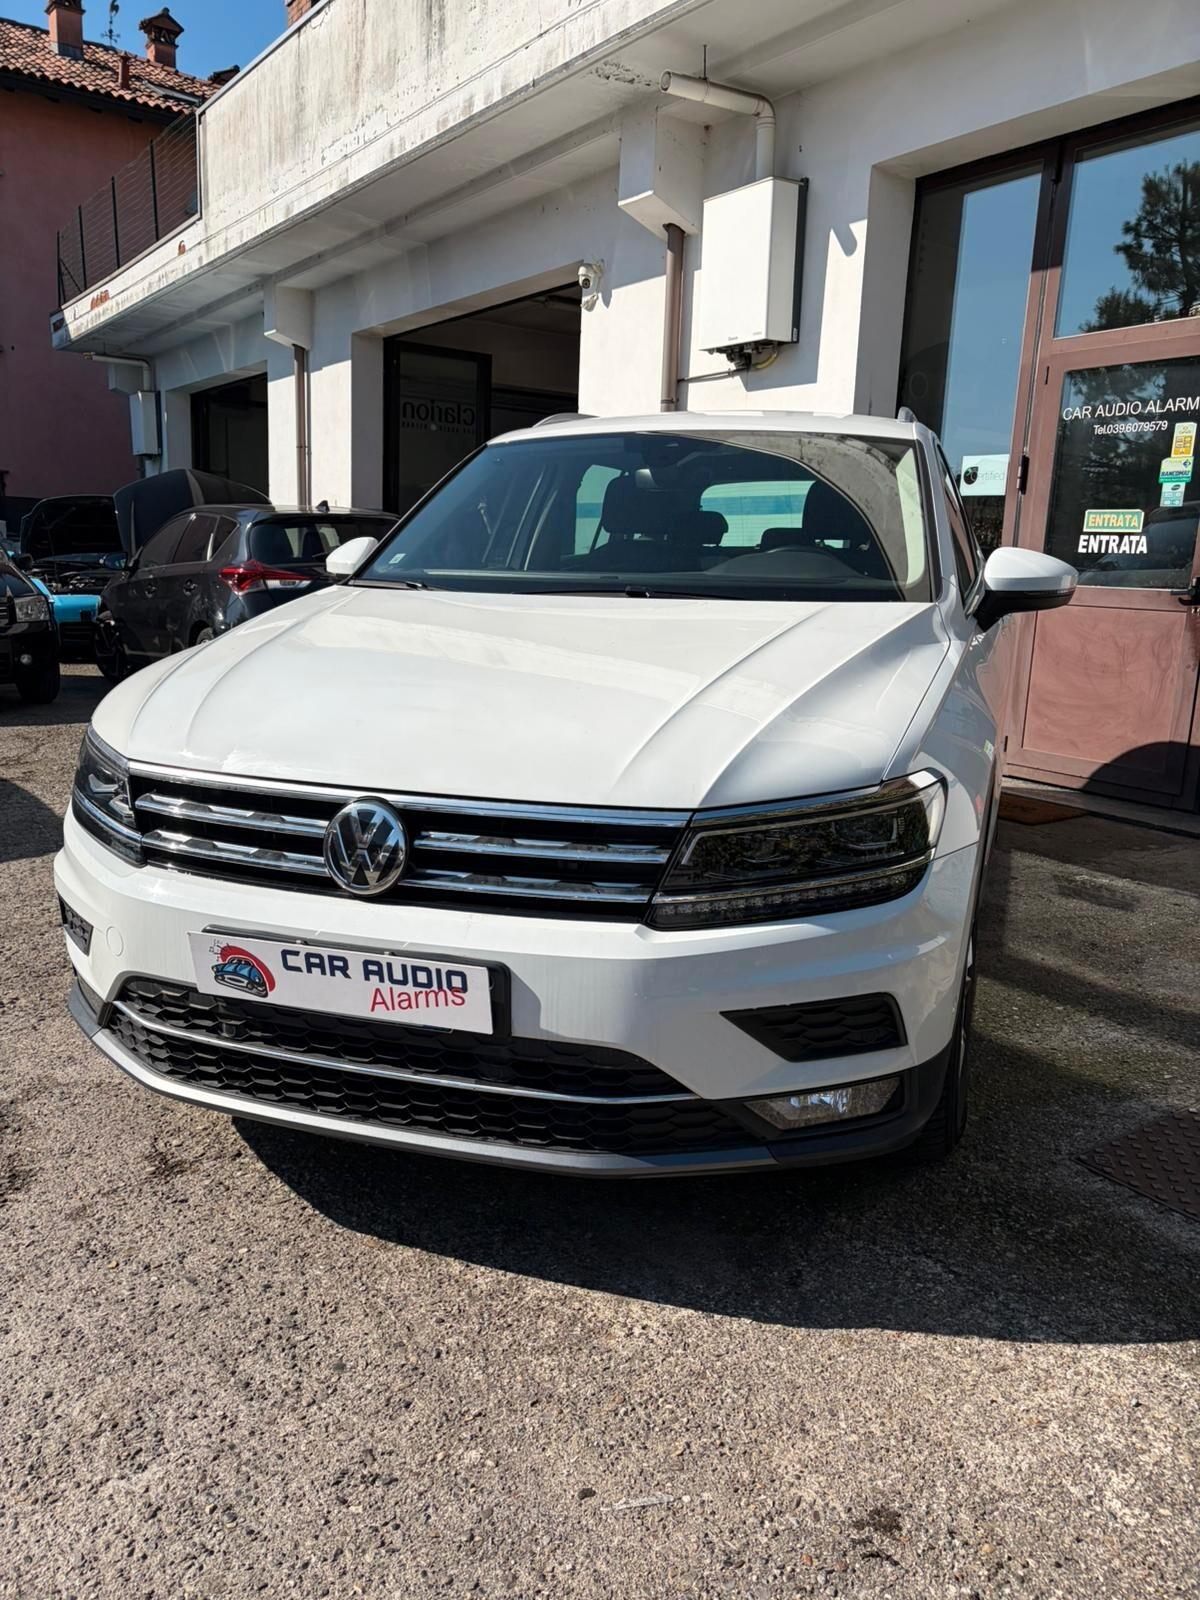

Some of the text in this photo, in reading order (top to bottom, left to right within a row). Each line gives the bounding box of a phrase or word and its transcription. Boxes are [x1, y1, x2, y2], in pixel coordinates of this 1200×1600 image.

[1062, 397, 1200, 421] CAR AUDIO ALARM
[1088, 513, 1139, 528] ENTRATA
[1077, 535, 1148, 554] ENTRATA
[281, 948, 468, 994] CAR AUDIO
[370, 984, 466, 1013] Alarms
